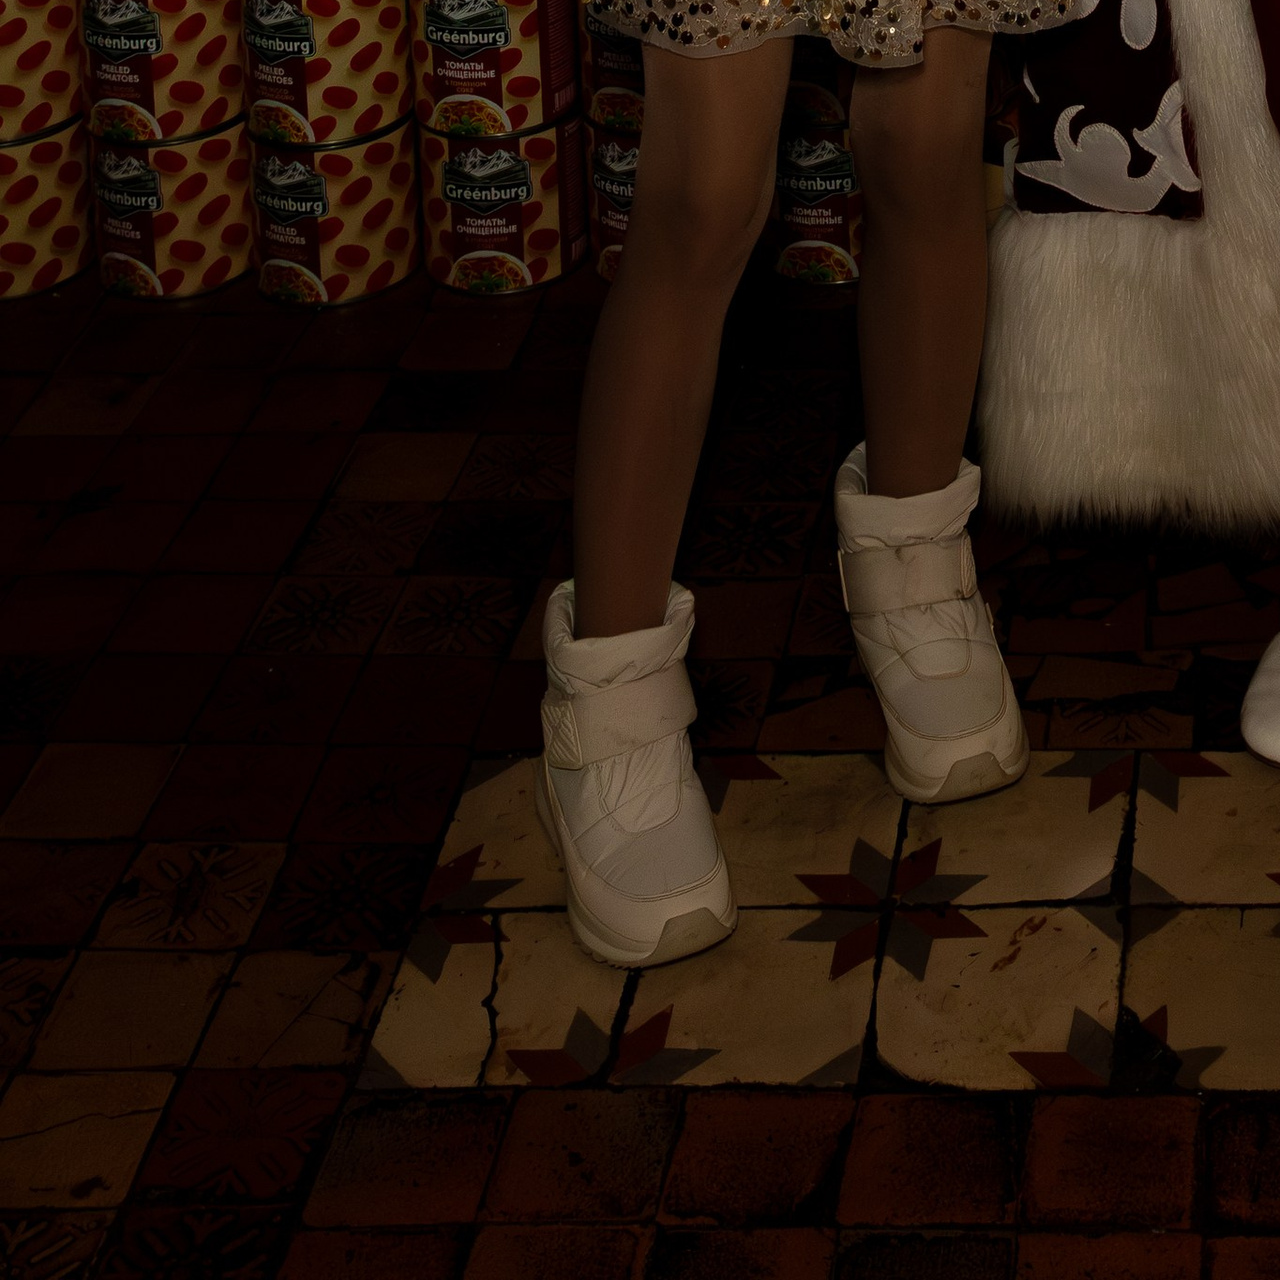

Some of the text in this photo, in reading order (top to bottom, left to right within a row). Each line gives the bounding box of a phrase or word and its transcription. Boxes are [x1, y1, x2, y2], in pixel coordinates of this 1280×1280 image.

[444, 60, 484, 71] ТОМАТЫ
[437, 68, 496, 79] ОЧИЩЕННЫЕ
[466, 217, 506, 227] ТОМАТЫ
[456, 225, 517, 236] ОЧИЩЕННЫЕ
